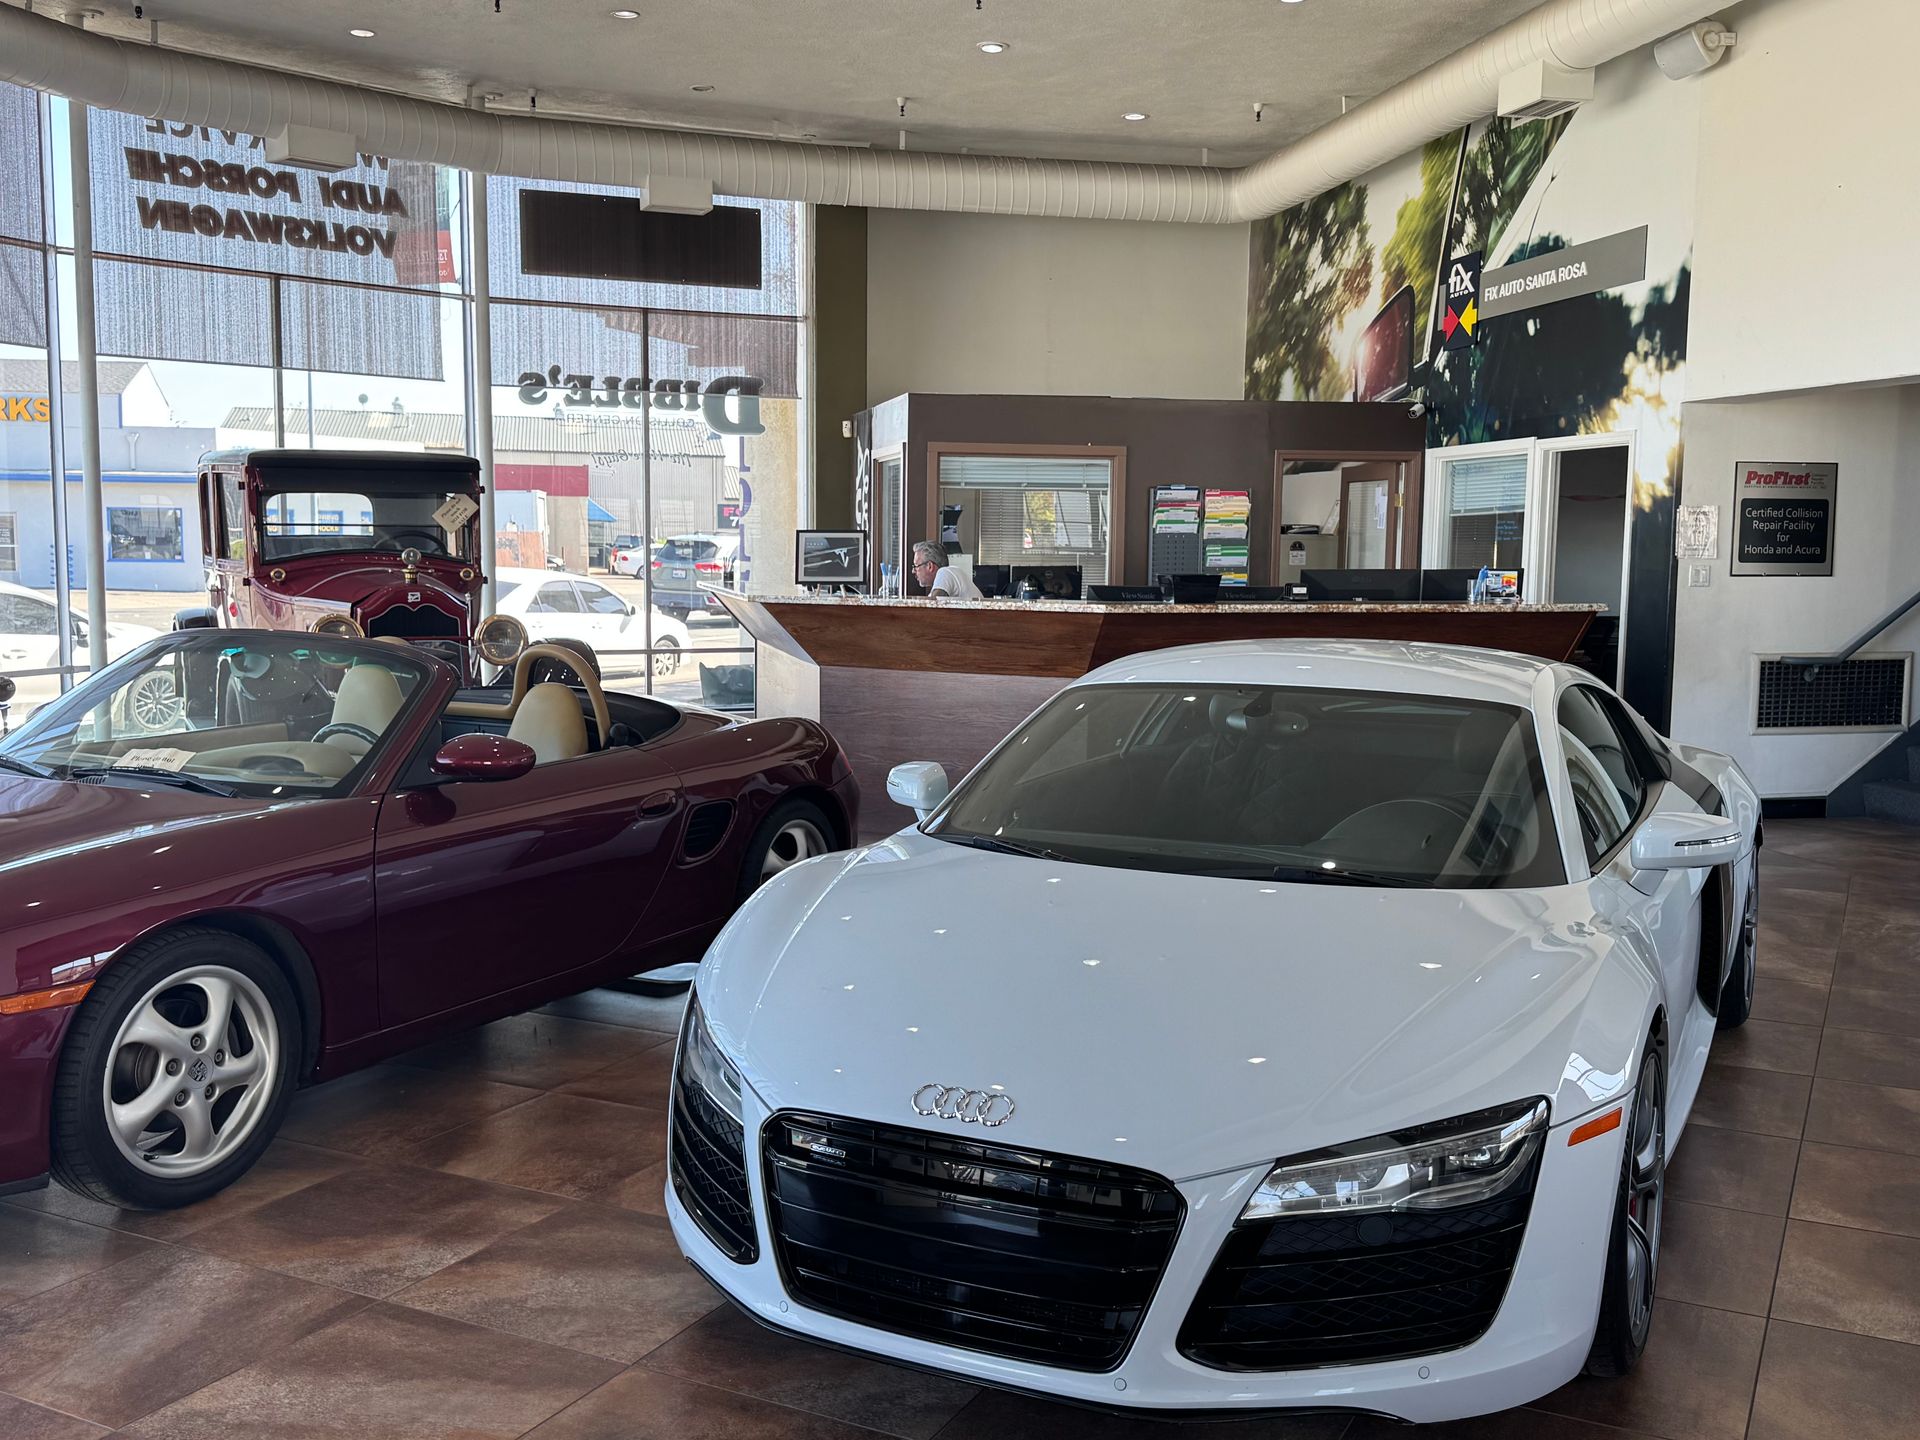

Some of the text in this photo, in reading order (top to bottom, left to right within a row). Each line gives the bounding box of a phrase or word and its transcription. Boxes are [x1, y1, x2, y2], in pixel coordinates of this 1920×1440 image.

[1448, 262, 1475, 293] fix
[1484, 261, 1588, 302] FIX AUTO SANTA ROSA
[1450, 290, 1469, 298] AUTO
[1745, 470, 1811, 485] ProFirst
[1745, 506, 1823, 519] Certified Collision
[1752, 520, 1815, 533] Repair Facility
[1776, 532, 1790, 542] for
[1744, 544, 1821, 555] Honda and Acura
